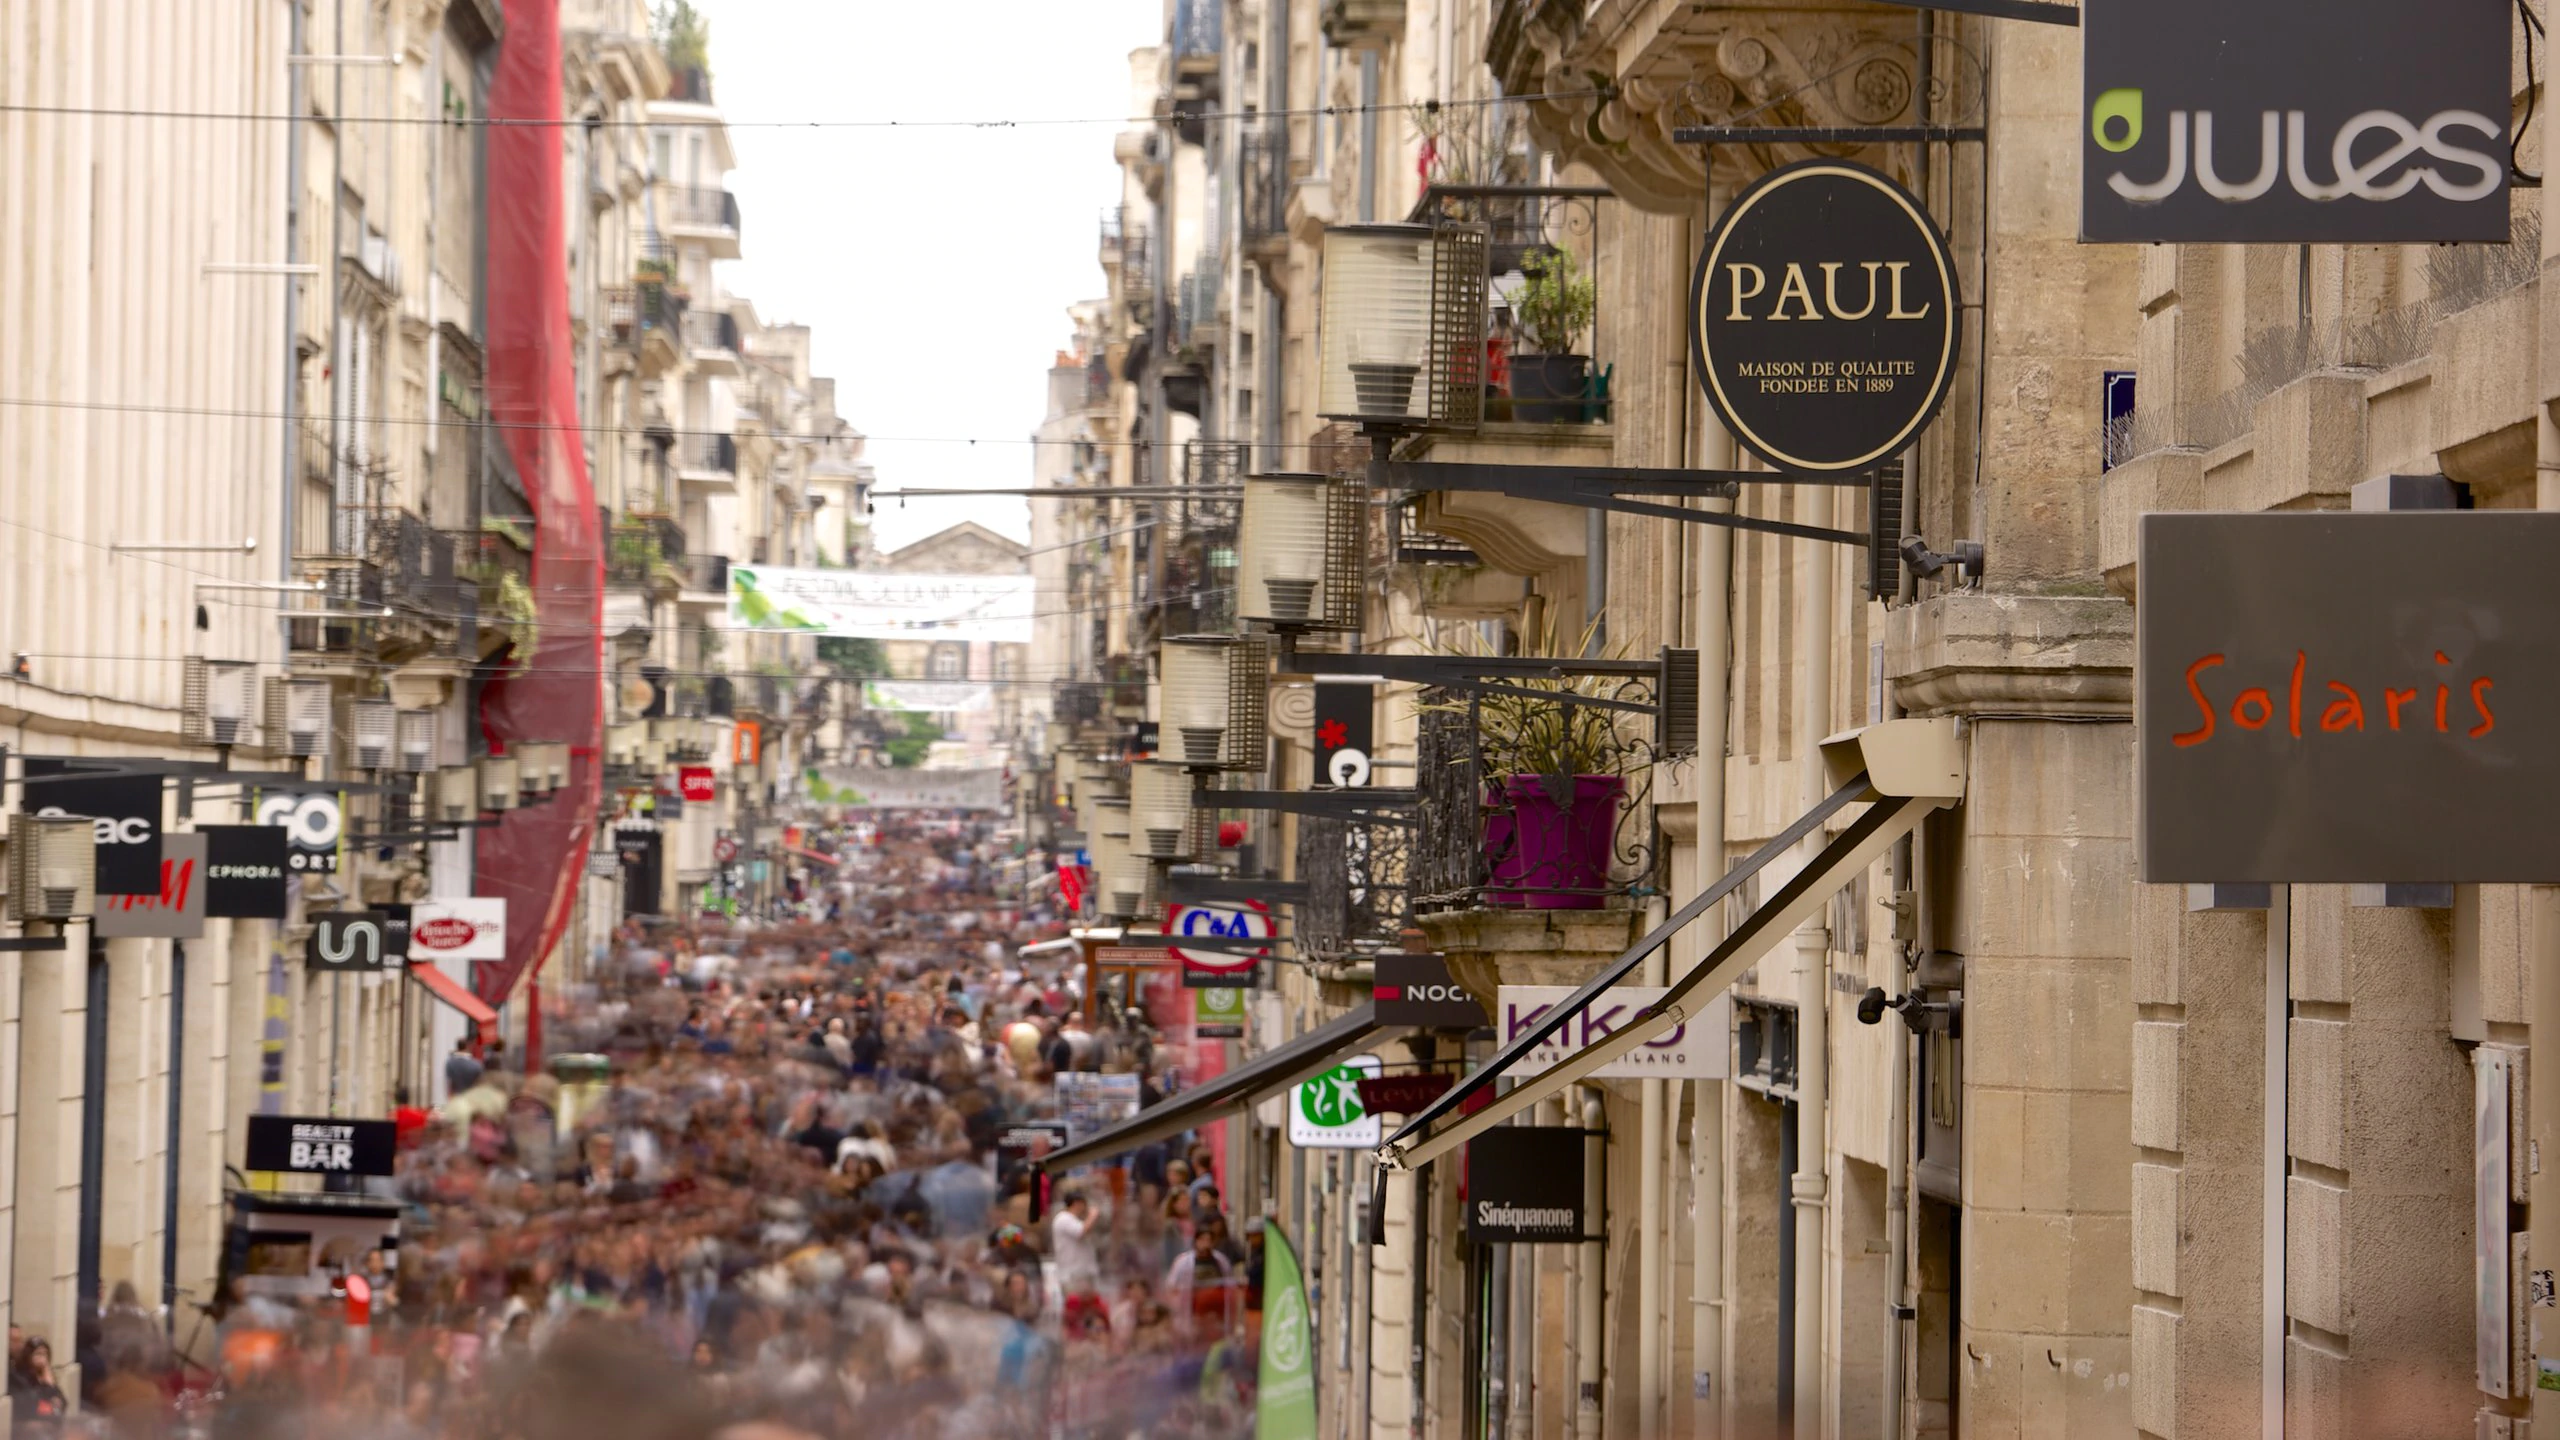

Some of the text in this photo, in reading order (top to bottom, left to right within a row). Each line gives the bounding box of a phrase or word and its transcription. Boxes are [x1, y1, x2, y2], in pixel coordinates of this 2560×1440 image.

[1725, 261, 1931, 321] PAUL
[1738, 361, 1916, 378] MAISON DE QUALITE
[1836, 379, 1859, 392] EN
[1865, 378, 1894, 392] 1889
[2172, 649, 2495, 748] Solaris
[256, 795, 340, 845] GO
[208, 865, 281, 879] EPHORA
[1522, 1053, 1560, 1063] AKE
[292, 1124, 354, 1141] BEAUTY
[290, 1142, 354, 1170] BAR
[1478, 1200, 1575, 1234] Sinéquanone
